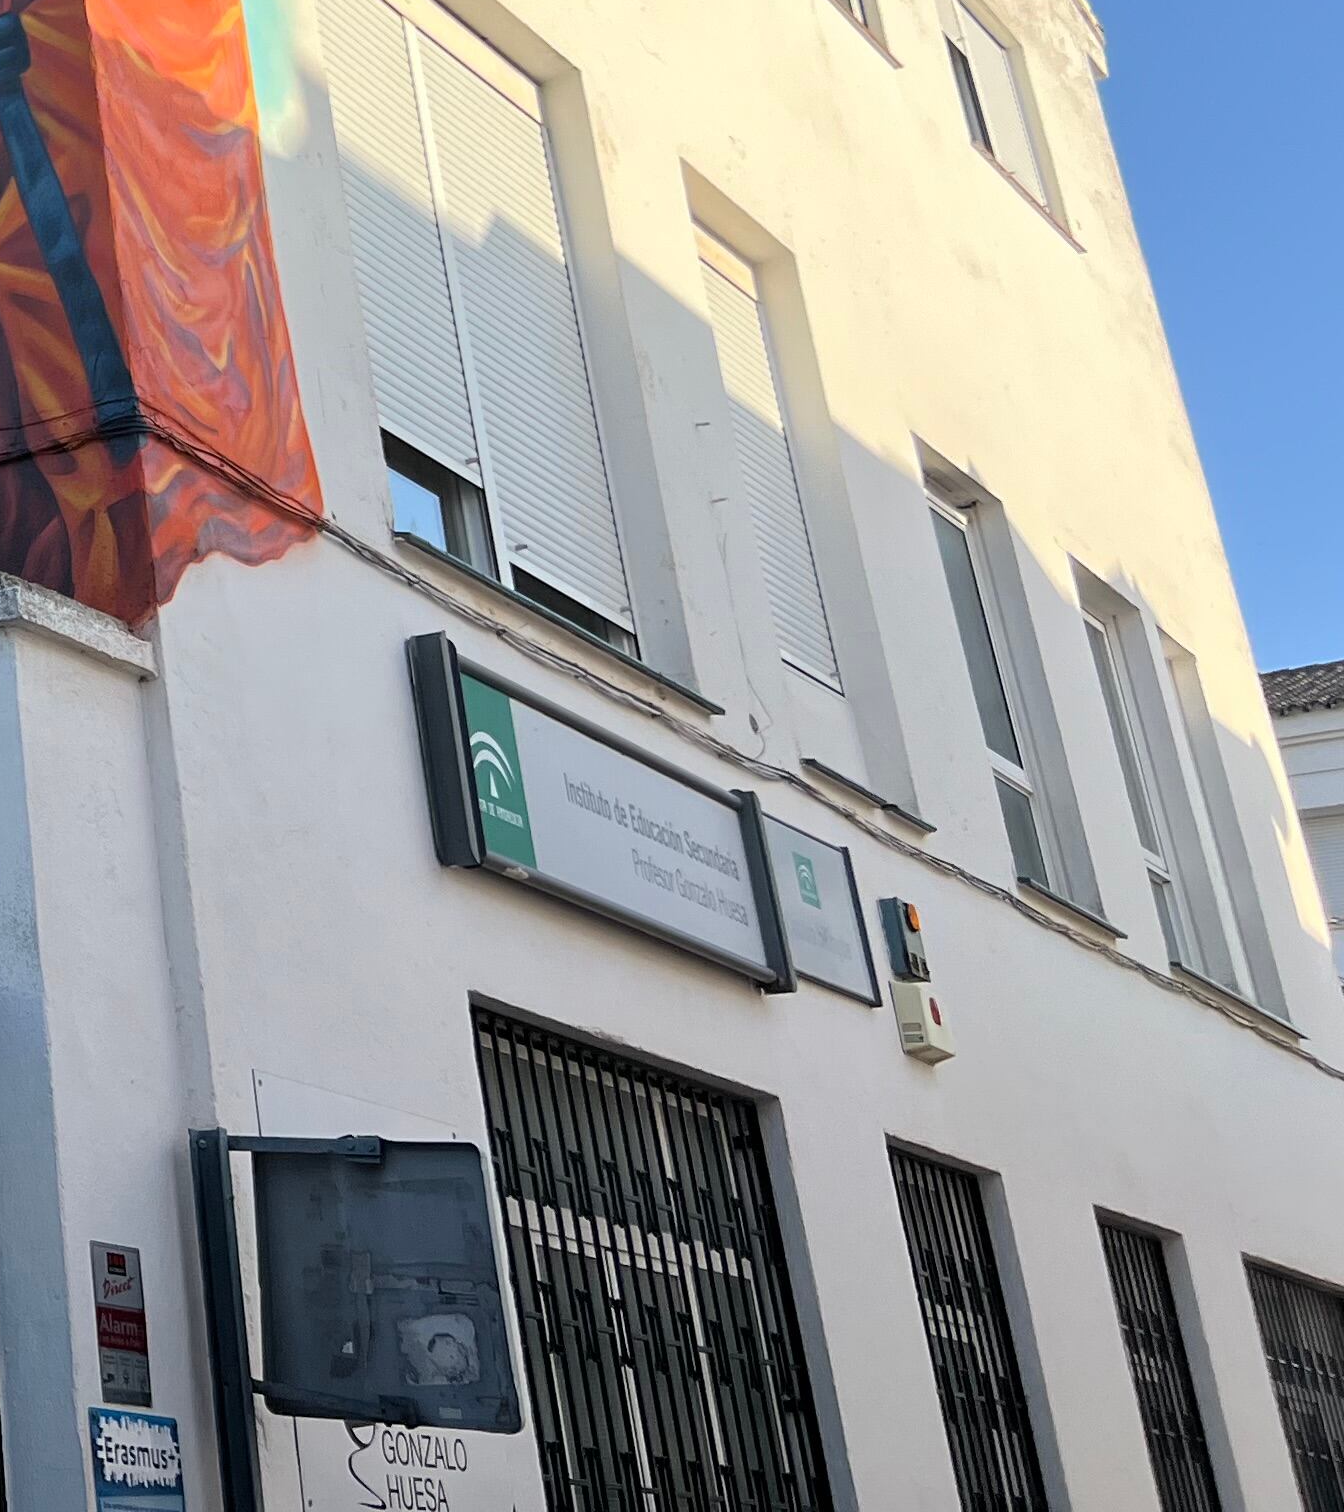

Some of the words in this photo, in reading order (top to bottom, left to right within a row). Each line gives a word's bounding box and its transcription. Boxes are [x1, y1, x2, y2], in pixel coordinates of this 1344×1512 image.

[563, 772, 612, 821] Instituto
[613, 797, 629, 828] de
[628, 803, 684, 854] Educación
[683, 830, 740, 882] Secundaria
[631, 848, 675, 893] Profesor
[103, 1435, 176, 1470] Erasmus+
[381, 1429, 468, 1473] GONZALO
[385, 1473, 450, 1512] HUESA
